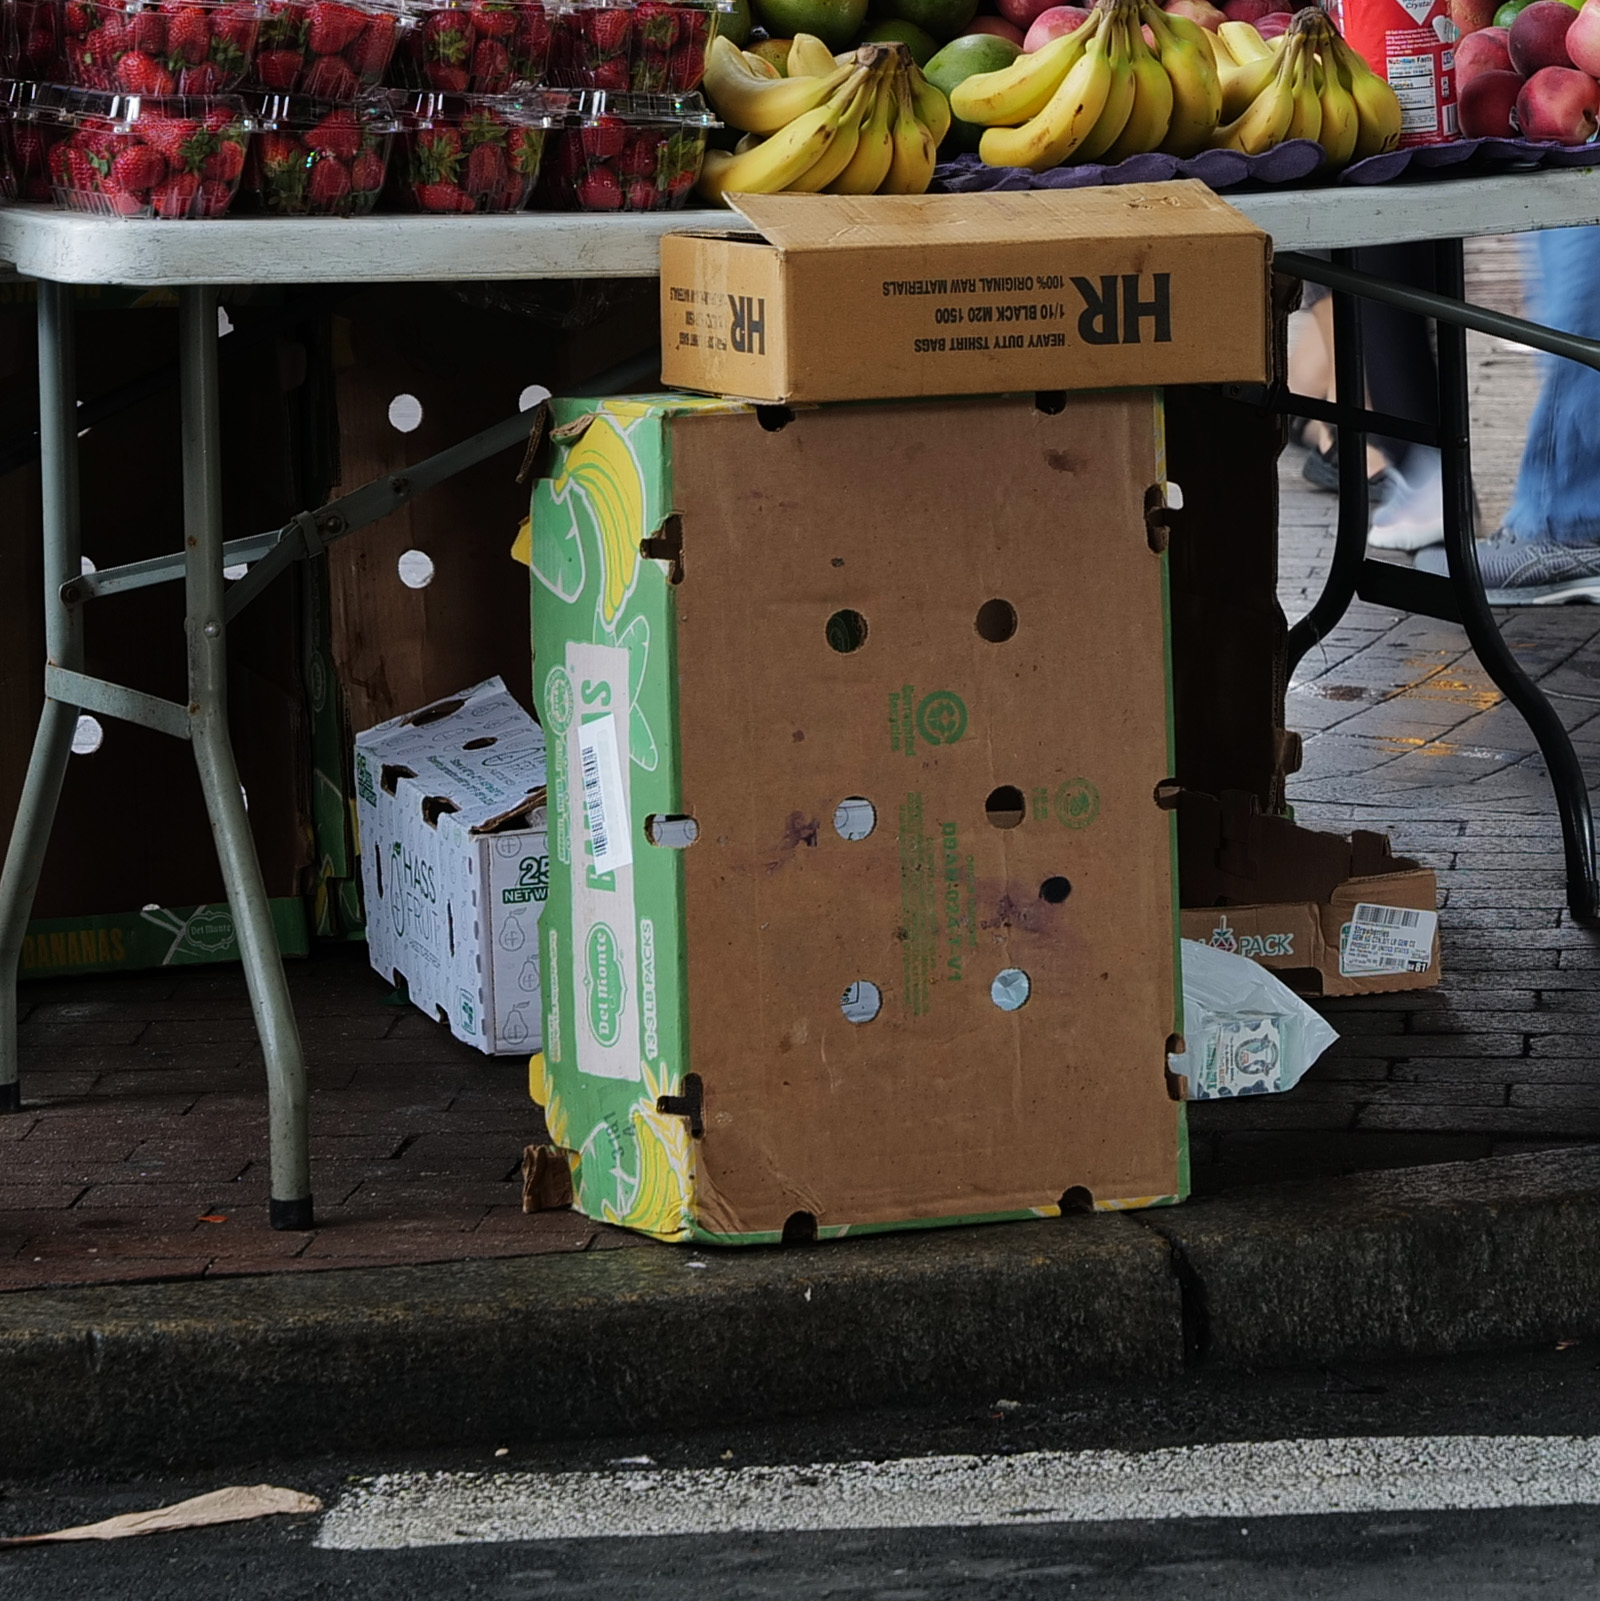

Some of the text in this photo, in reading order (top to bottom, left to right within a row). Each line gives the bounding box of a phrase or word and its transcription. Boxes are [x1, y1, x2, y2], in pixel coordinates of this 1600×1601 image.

[1405, 1, 1433, 11] Crystal
[1387, 56, 1416, 66] Nutrition
[1416, 55, 1434, 65] Facts
[882, 275, 1065, 297] 100% ORIGINAL RAW MATERIALS
[728, 294, 765, 356] HR
[935, 302, 1065, 325] 1/10 BLACK M20 1500
[1069, 272, 1172, 346] HR
[914, 333, 1066, 353] HEAVY DUTY TSHIRT BAGS
[402, 847, 437, 904] HASS
[504, 889, 532, 904] NET
[406, 891, 439, 947] FRUIT
[22, 927, 127, 970] BANANAS
[640, 919, 656, 986] PACKS
[1240, 932, 1295, 958] PACK
[596, 931, 610, 1036] Del Monte
